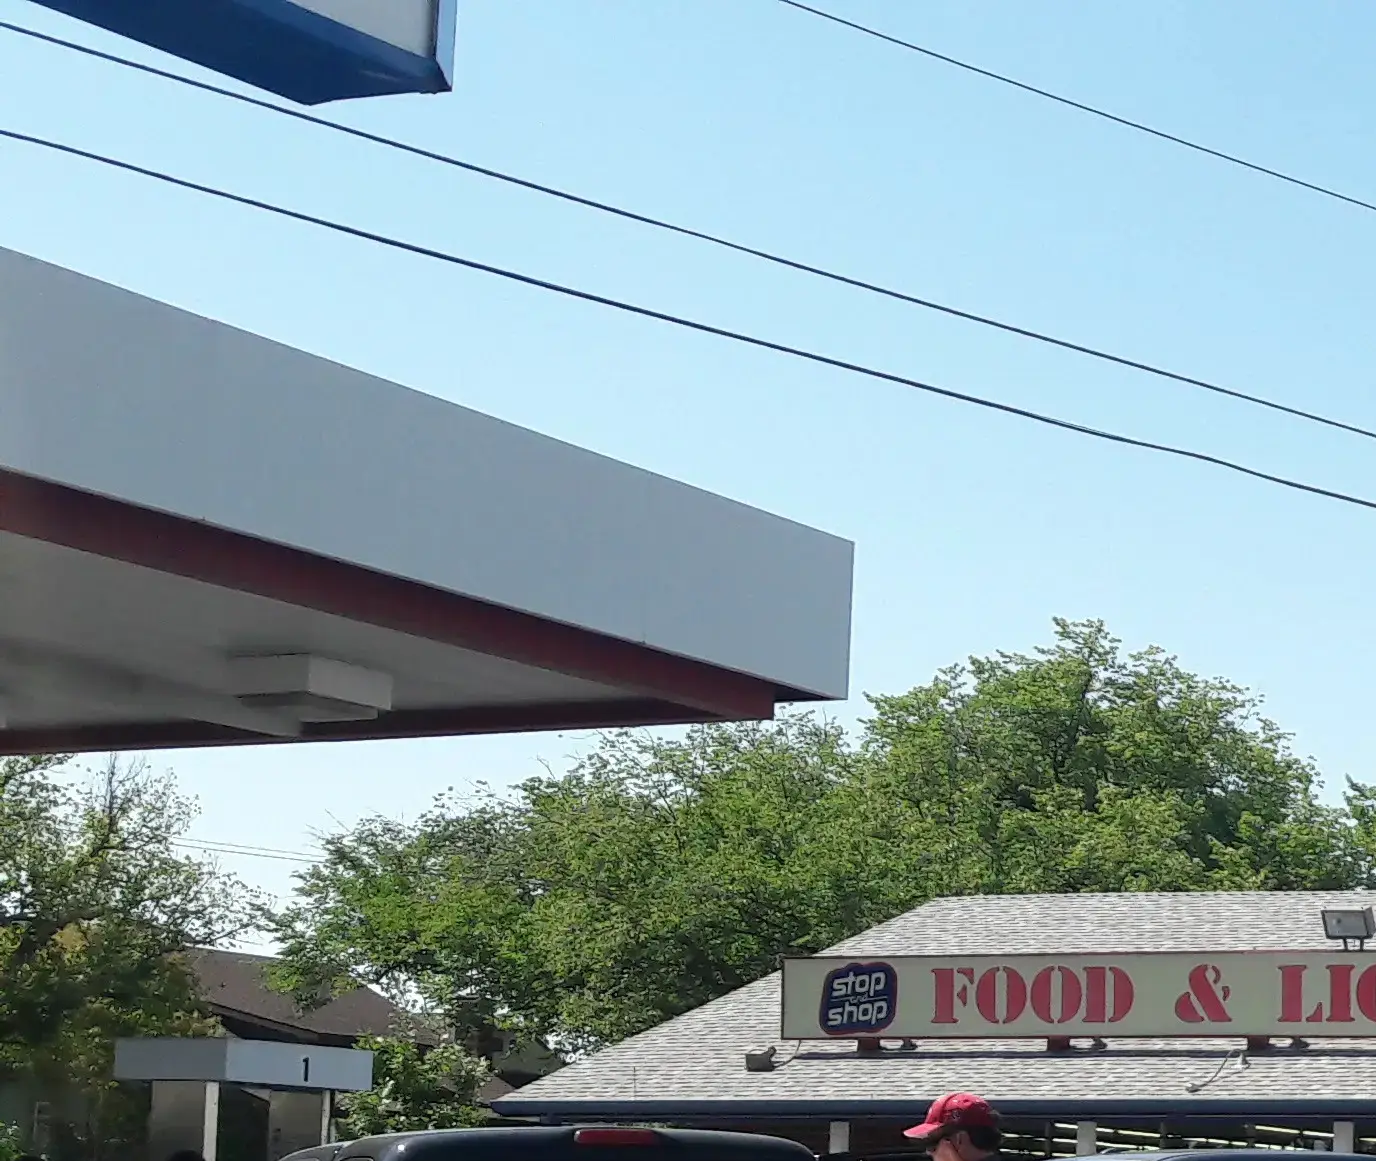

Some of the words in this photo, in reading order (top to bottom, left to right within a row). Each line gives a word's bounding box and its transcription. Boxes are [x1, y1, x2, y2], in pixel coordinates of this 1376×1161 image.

[832, 971, 886, 997] stop
[930, 965, 1134, 1024] FOOD
[1174, 964, 1233, 1023] &
[827, 1001, 888, 1026] shop
[302, 1057, 310, 1082] 1
